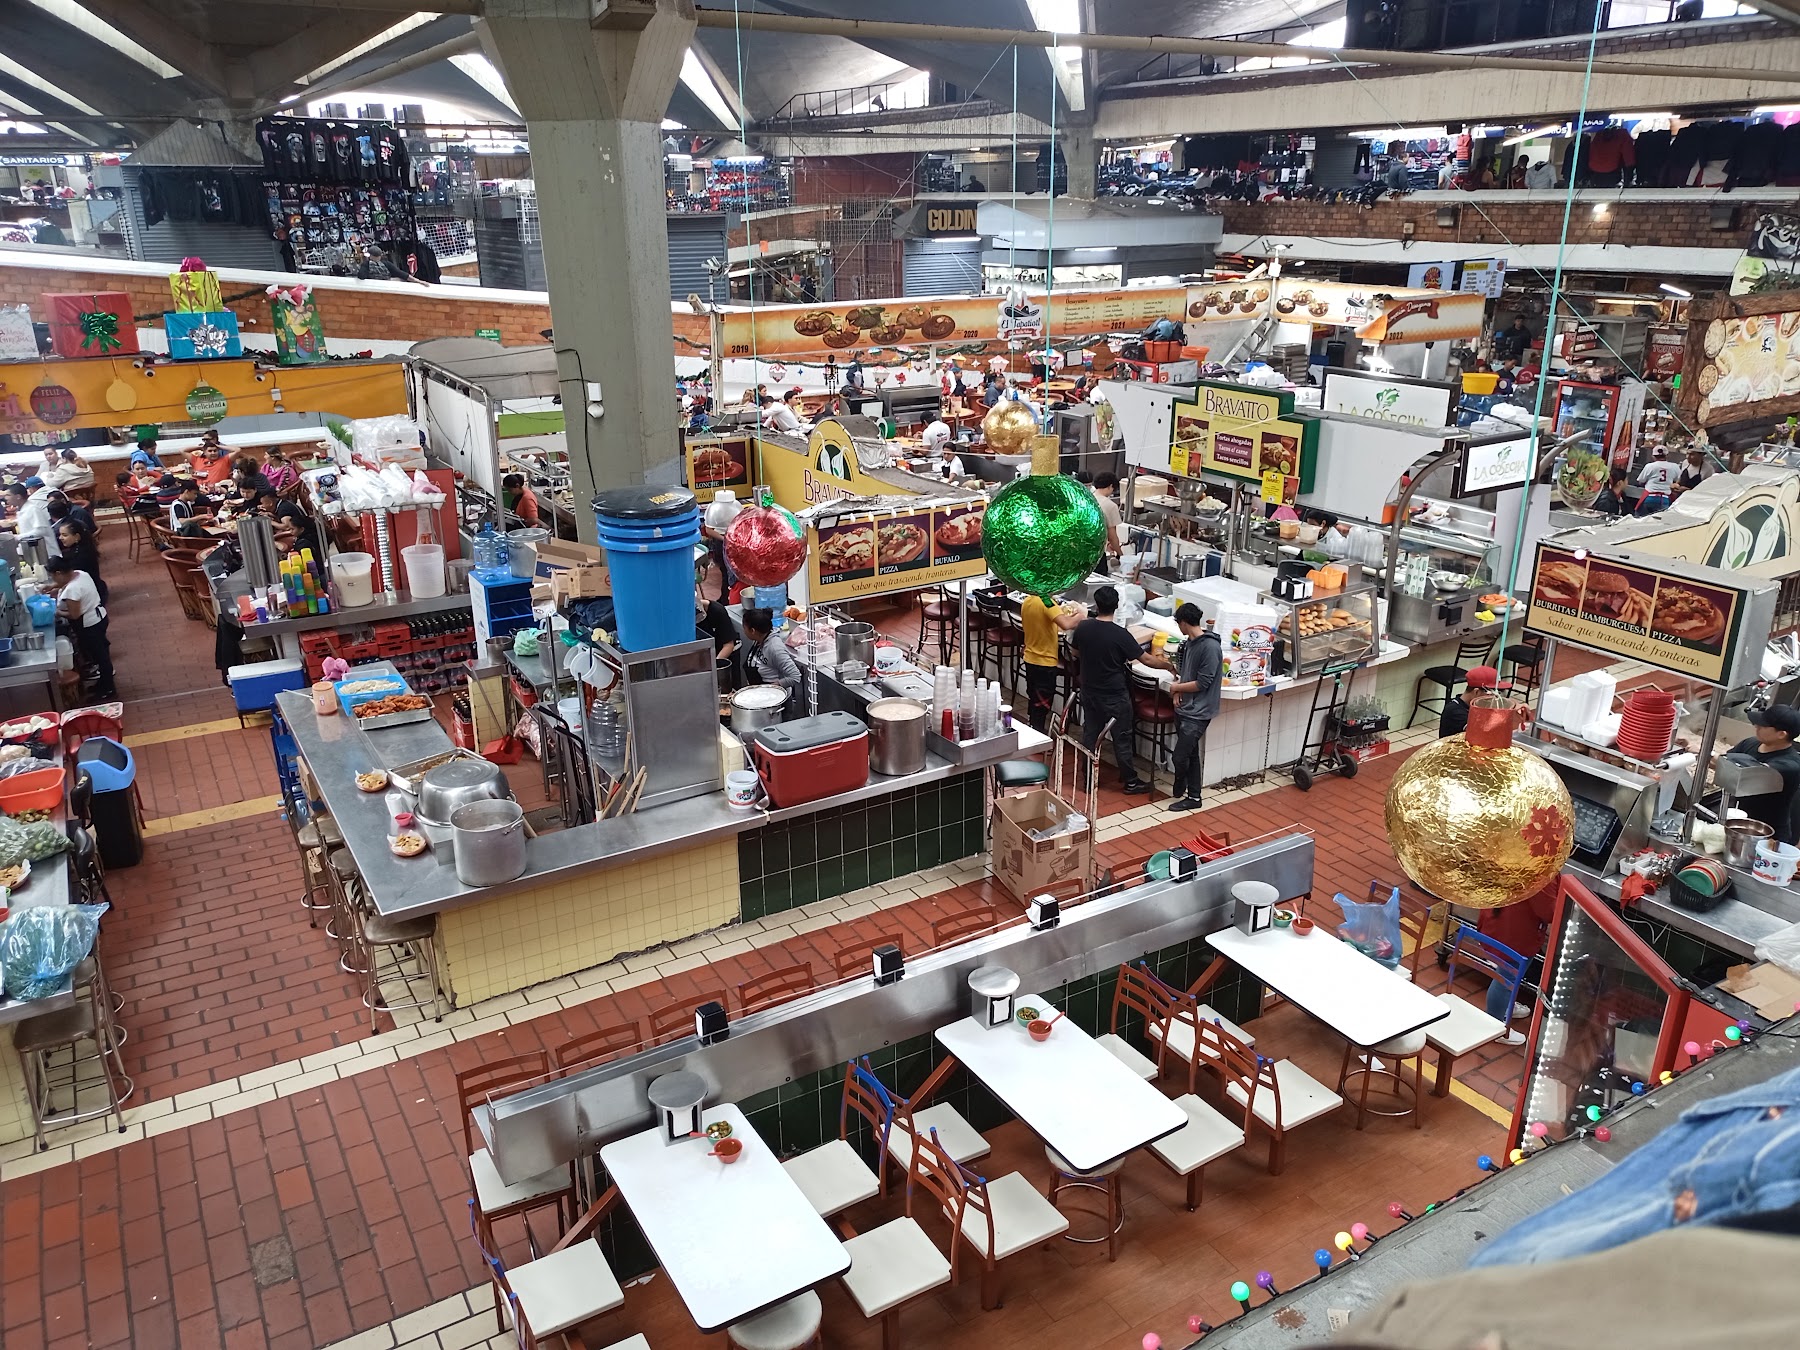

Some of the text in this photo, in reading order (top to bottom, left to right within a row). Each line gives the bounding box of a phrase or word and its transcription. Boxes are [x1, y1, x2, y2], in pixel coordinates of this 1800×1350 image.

[3, 157, 65, 165] SANITARIOS
[1110, 322, 1125, 330] 2021
[963, 330, 978, 338] 2020
[1389, 331, 1404, 341] 2022
[731, 345, 749, 354] 2019
[41, 388, 60, 396] FELIZ
[1205, 389, 1270, 421] BRAVATTO
[1216, 434, 1252, 446] Tortas ahogadas
[1218, 443, 1231, 452] Tacos
[1216, 453, 1249, 466] Tacos sencillos
[1473, 467, 1488, 480] LA
[1489, 460, 1527, 476] COSECHA
[1659, 470, 1667, 482] 3
[804, 470, 856, 503] BRAVATT
[934, 555, 960, 565] BUFALO
[879, 565, 899, 575] PIZZA
[851, 568, 956, 592] Sabor que trasciende fronteras
[1535, 598, 1577, 617] BURRITAS
[1581, 611, 1646, 636] HAMBURGUESA
[1545, 614, 1701, 668] Sabor que trasciende fronteras
[1652, 630, 1682, 646] PIZZA
